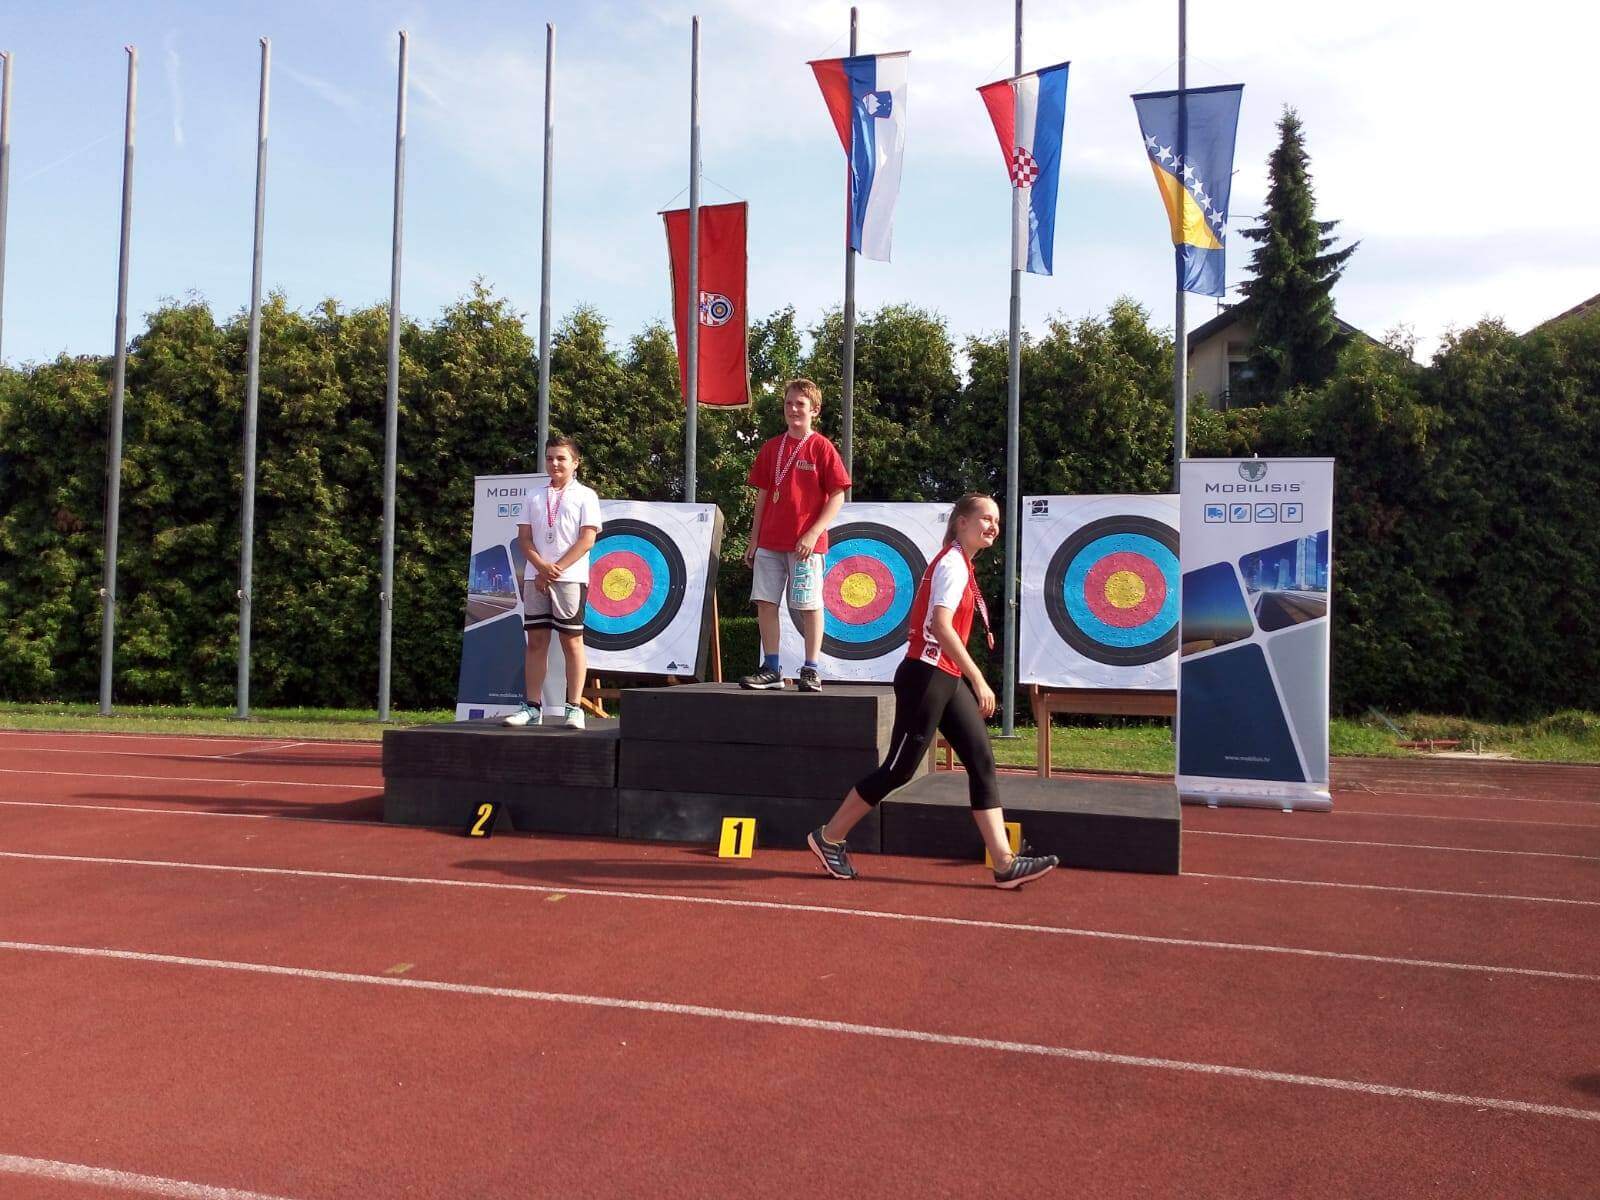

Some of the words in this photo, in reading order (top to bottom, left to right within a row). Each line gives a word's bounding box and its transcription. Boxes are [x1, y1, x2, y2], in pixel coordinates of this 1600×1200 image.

[1205, 482, 1301, 493] MOBILISIS
[1287, 507, 1297, 518] P
[470, 803, 493, 836] 2
[733, 822, 744, 855] 1
